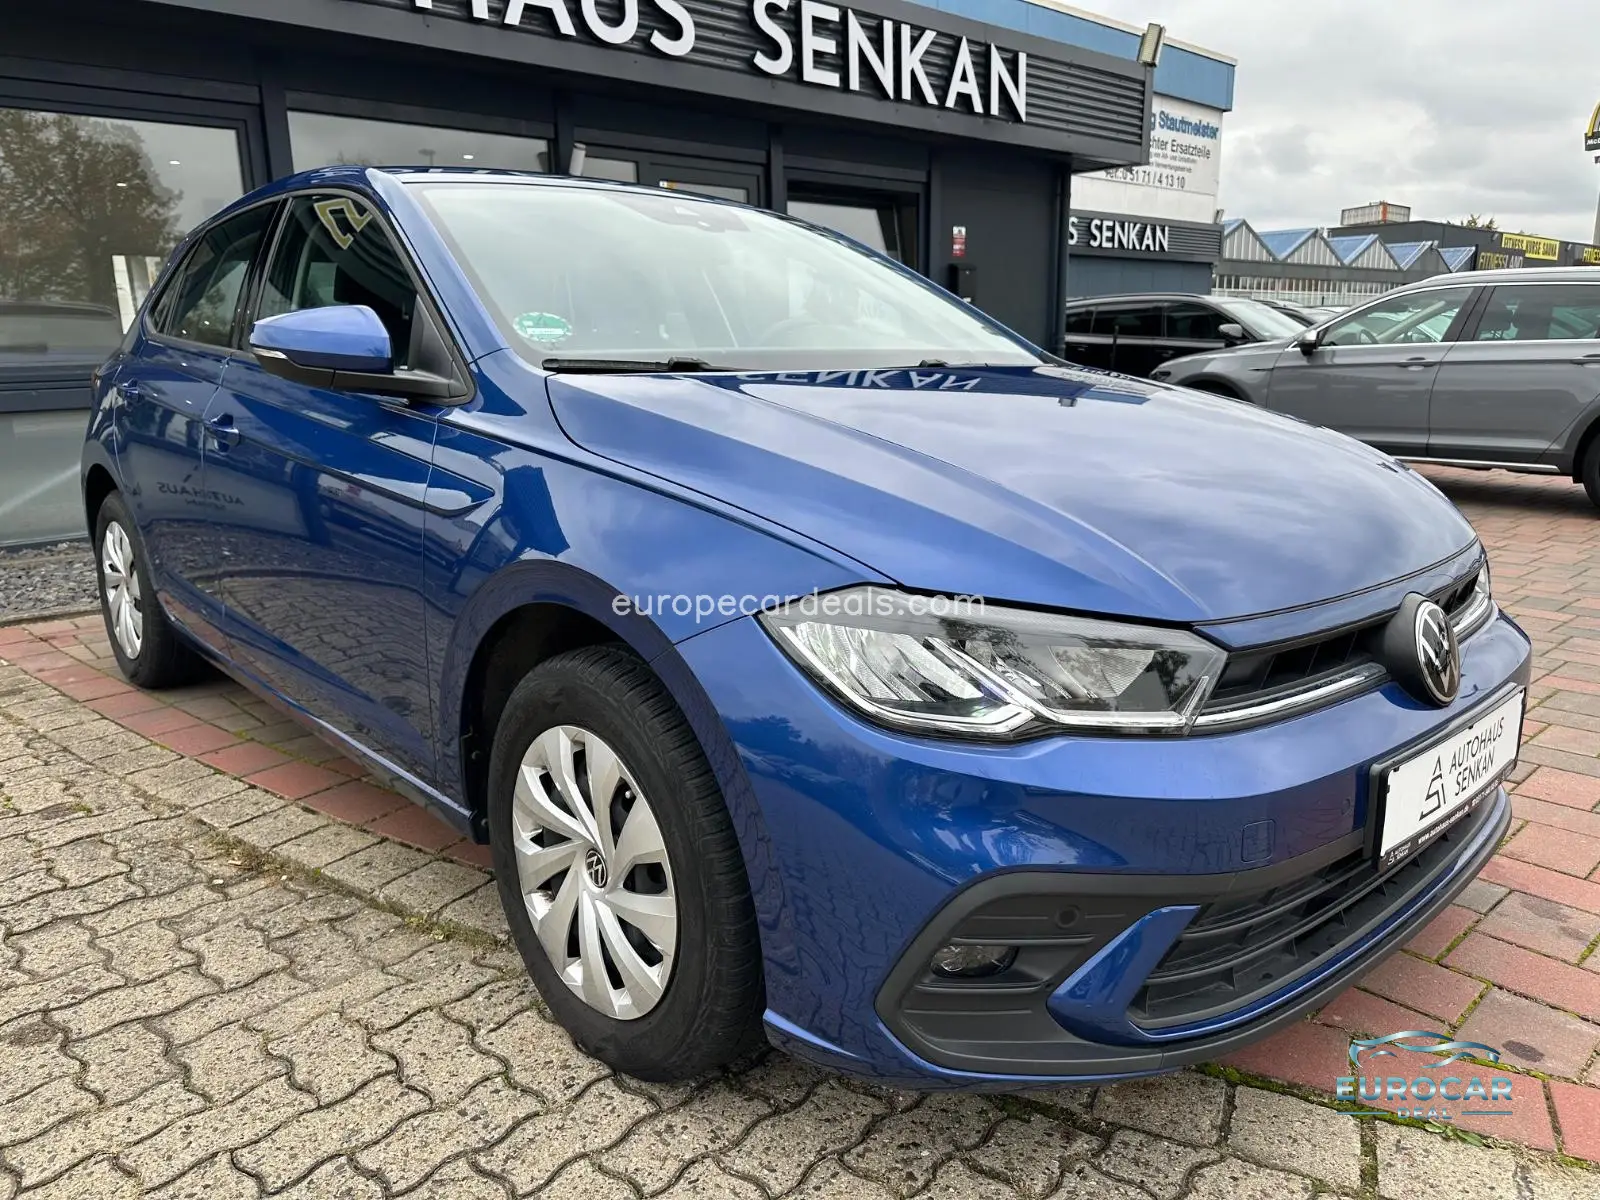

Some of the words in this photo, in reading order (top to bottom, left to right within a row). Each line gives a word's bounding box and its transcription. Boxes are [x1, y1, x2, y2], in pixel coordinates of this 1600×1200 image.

[753, 0, 1027, 123] SENKAN
[1159, 111, 1219, 139] Stautmeister
[1150, 136, 1169, 151] hter
[1171, 140, 1211, 160] Ersatzteile
[1142, 170, 1151, 184] 71
[1157, 172, 1163, 186] 4
[1165, 173, 1174, 188] 13
[1176, 175, 1185, 189] 10
[1068, 216, 1078, 245] S
[1089, 218, 1168, 252] SENKAN
[1449, 717, 1504, 774] AUTOHAUS
[1455, 746, 1495, 796] SENKAN
